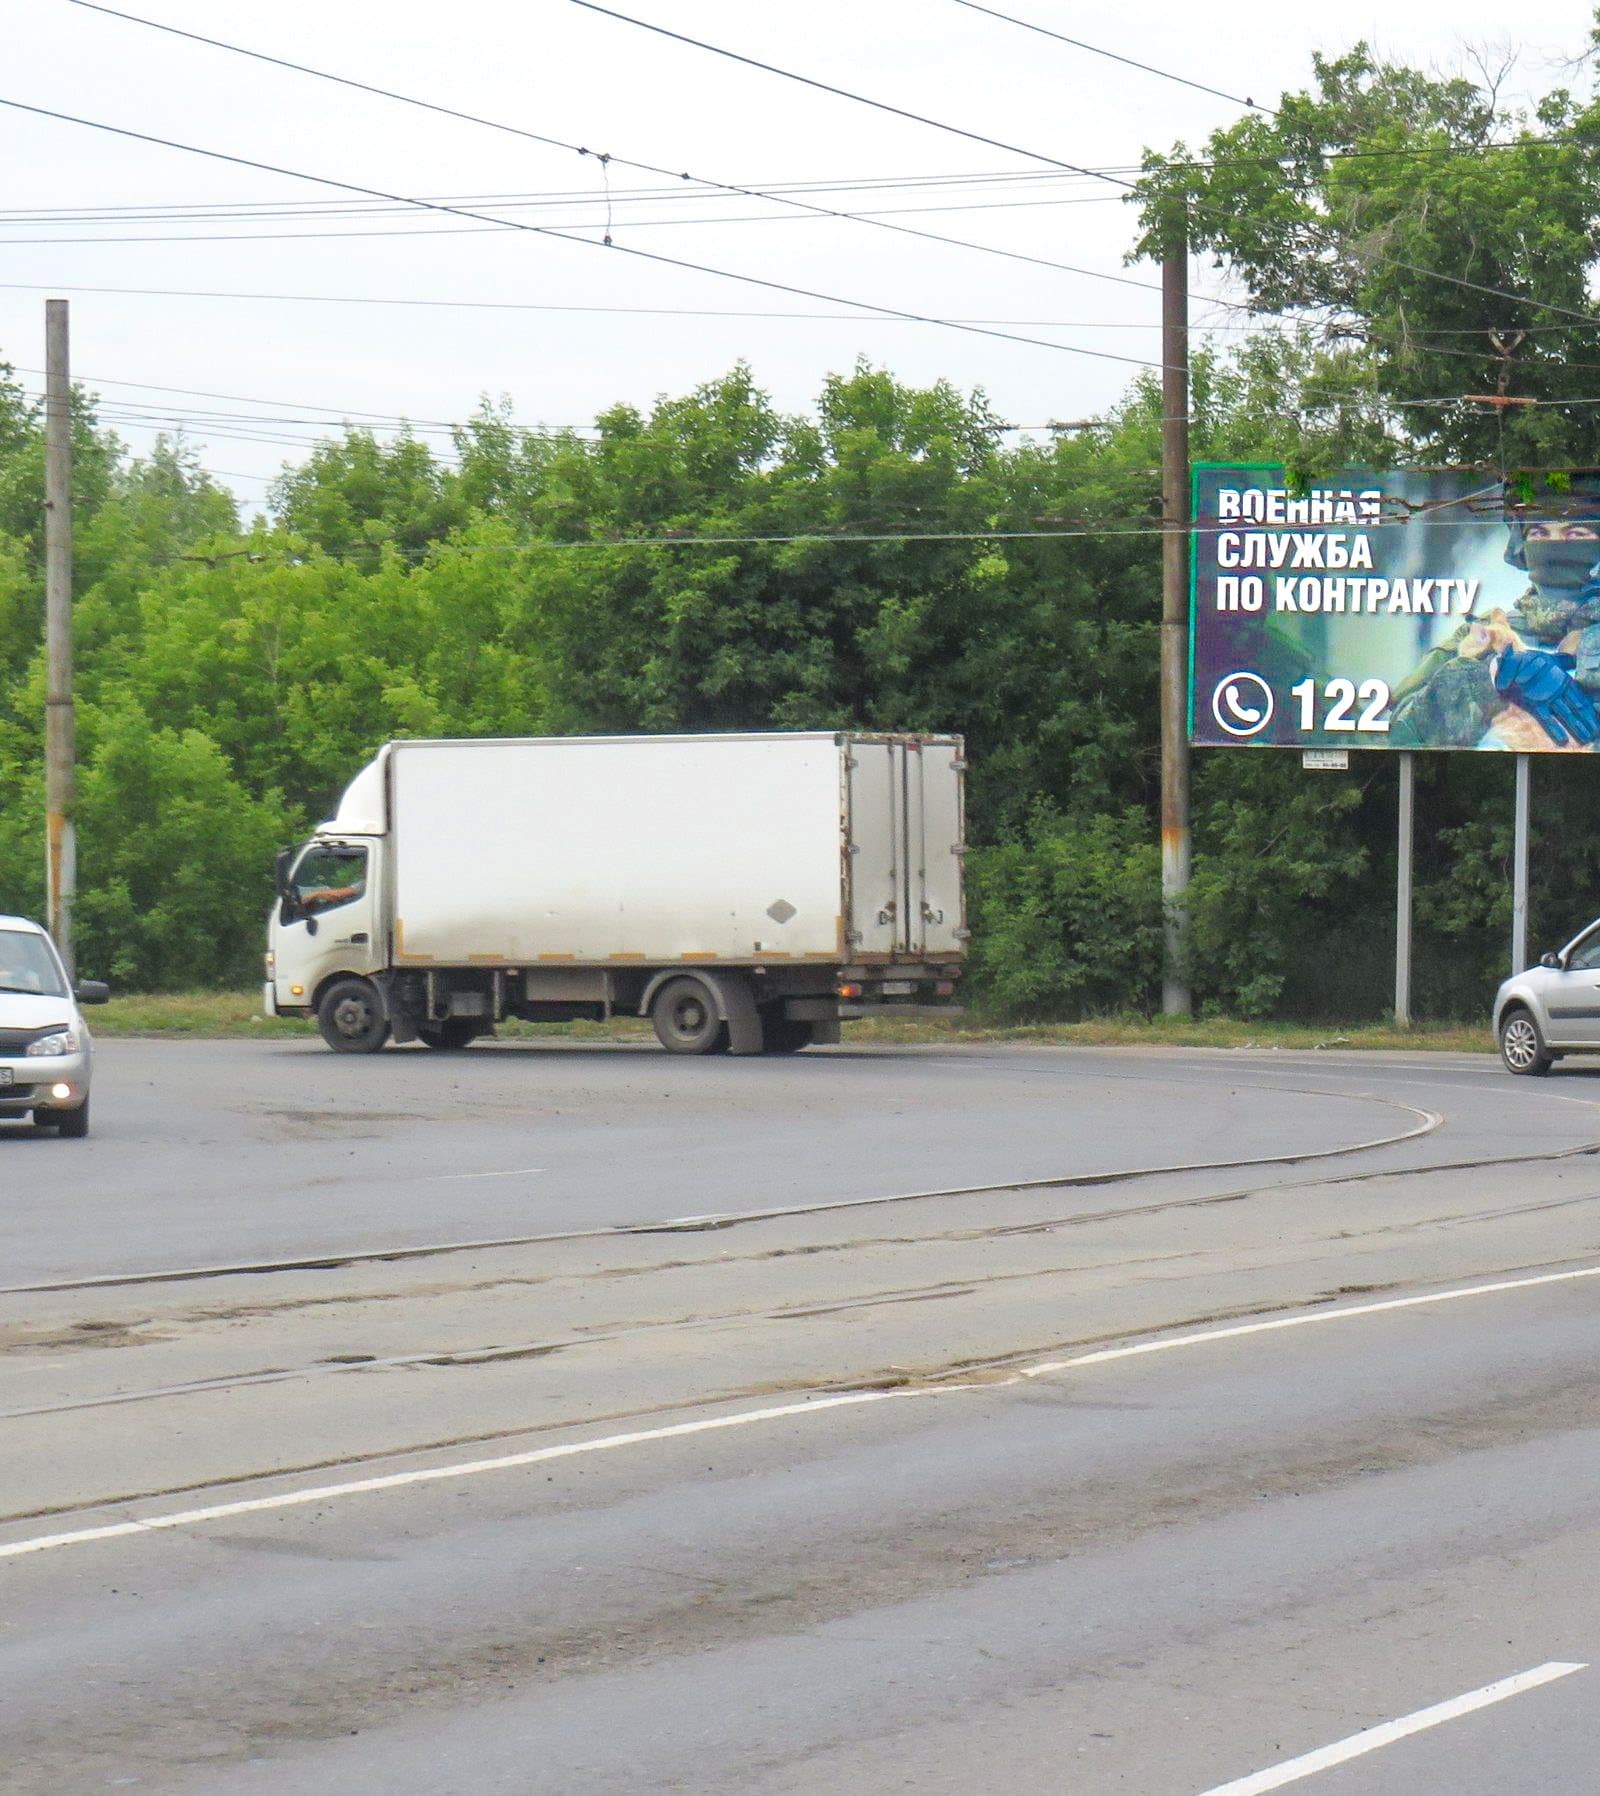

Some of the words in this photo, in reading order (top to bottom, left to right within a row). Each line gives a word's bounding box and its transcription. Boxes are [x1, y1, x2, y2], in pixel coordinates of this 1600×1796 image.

[1218, 489, 1381, 525] ВОЕННАЯ
[1217, 532, 1373, 569] СЛУЖБА
[1217, 576, 1263, 611] ПО
[1276, 576, 1479, 614] КОНТРАКТУ
[1291, 678, 1390, 731] 122
